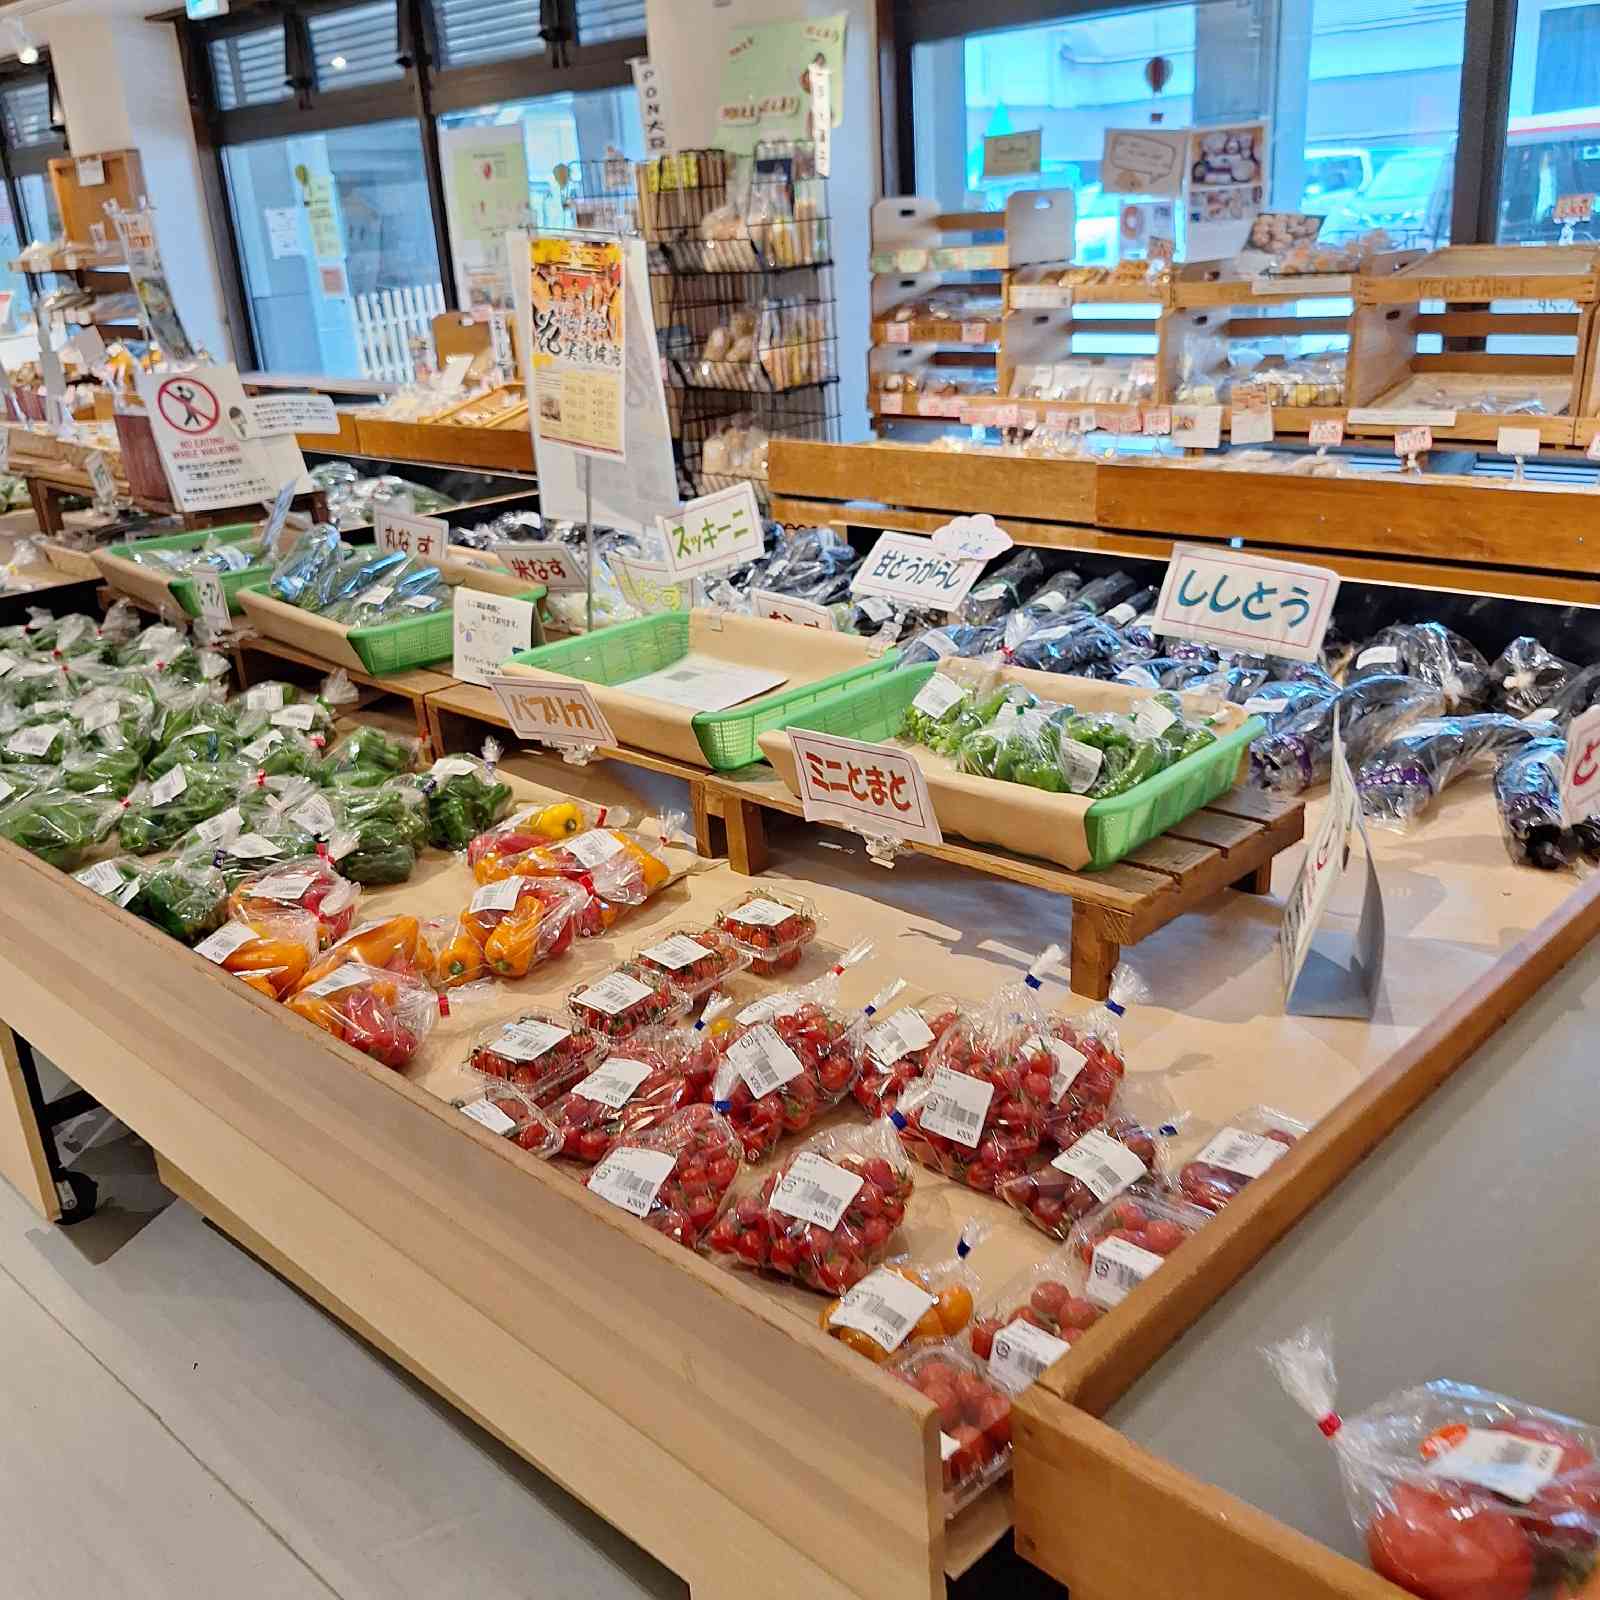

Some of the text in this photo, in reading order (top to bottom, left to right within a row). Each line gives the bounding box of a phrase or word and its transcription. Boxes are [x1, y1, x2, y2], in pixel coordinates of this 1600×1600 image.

[511, 556, 567, 581] 米なす
[872, 550, 963, 589] 甘とうがらし
[1178, 569, 1310, 628] ししとう
[805, 751, 912, 811] ミニとまと
